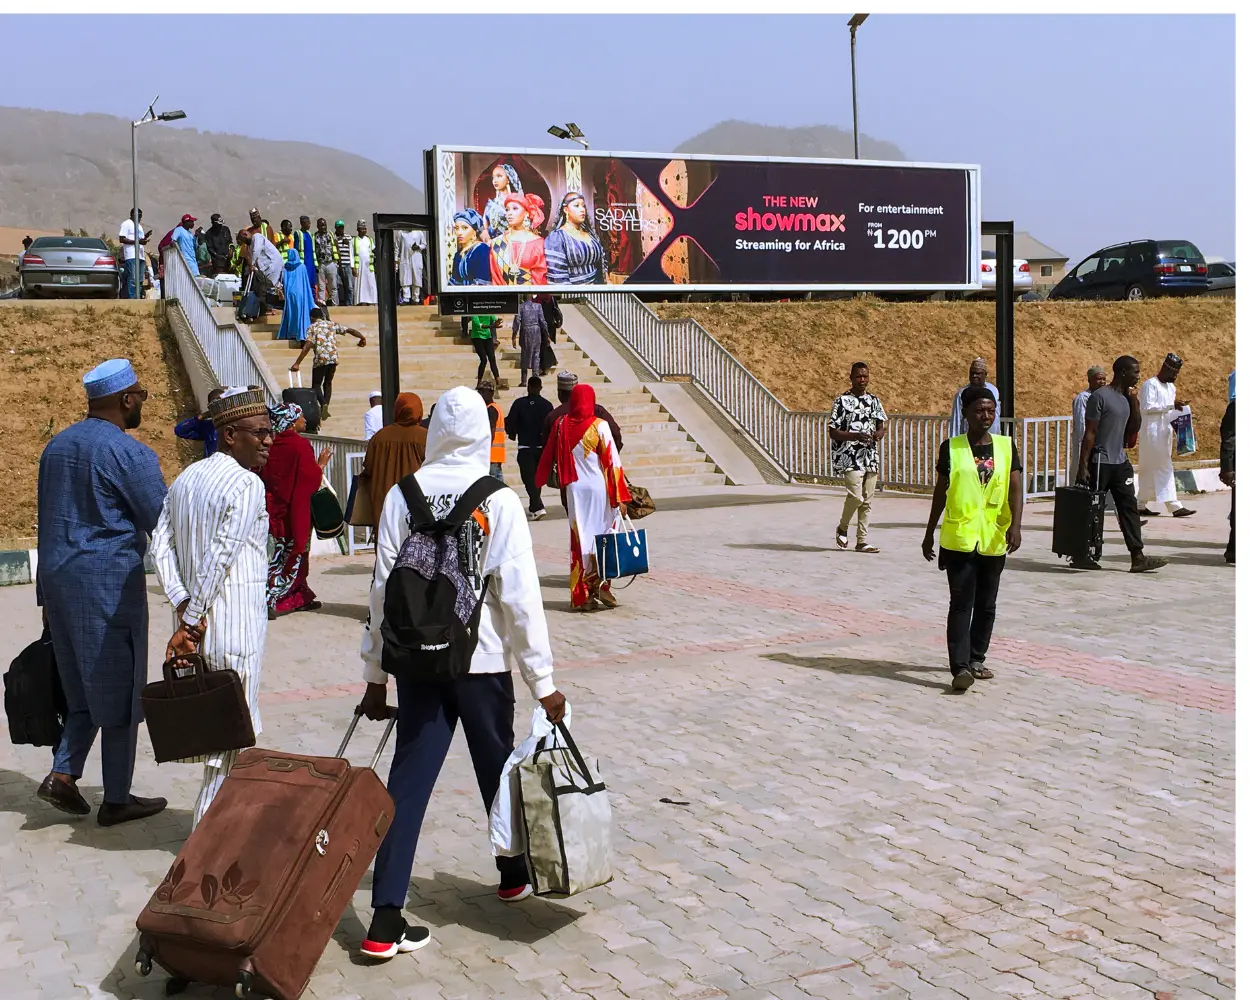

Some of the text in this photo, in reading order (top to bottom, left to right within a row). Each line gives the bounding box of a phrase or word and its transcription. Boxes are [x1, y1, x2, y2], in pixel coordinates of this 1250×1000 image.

[763, 196, 818, 208] THE NEW
[595, 208, 643, 220] SADAU
[858, 203, 944, 215] For entertainment
[735, 207, 846, 232] showmax
[924, 230, 937, 238] PM
[735, 239, 846, 252] Streaming for Africa
